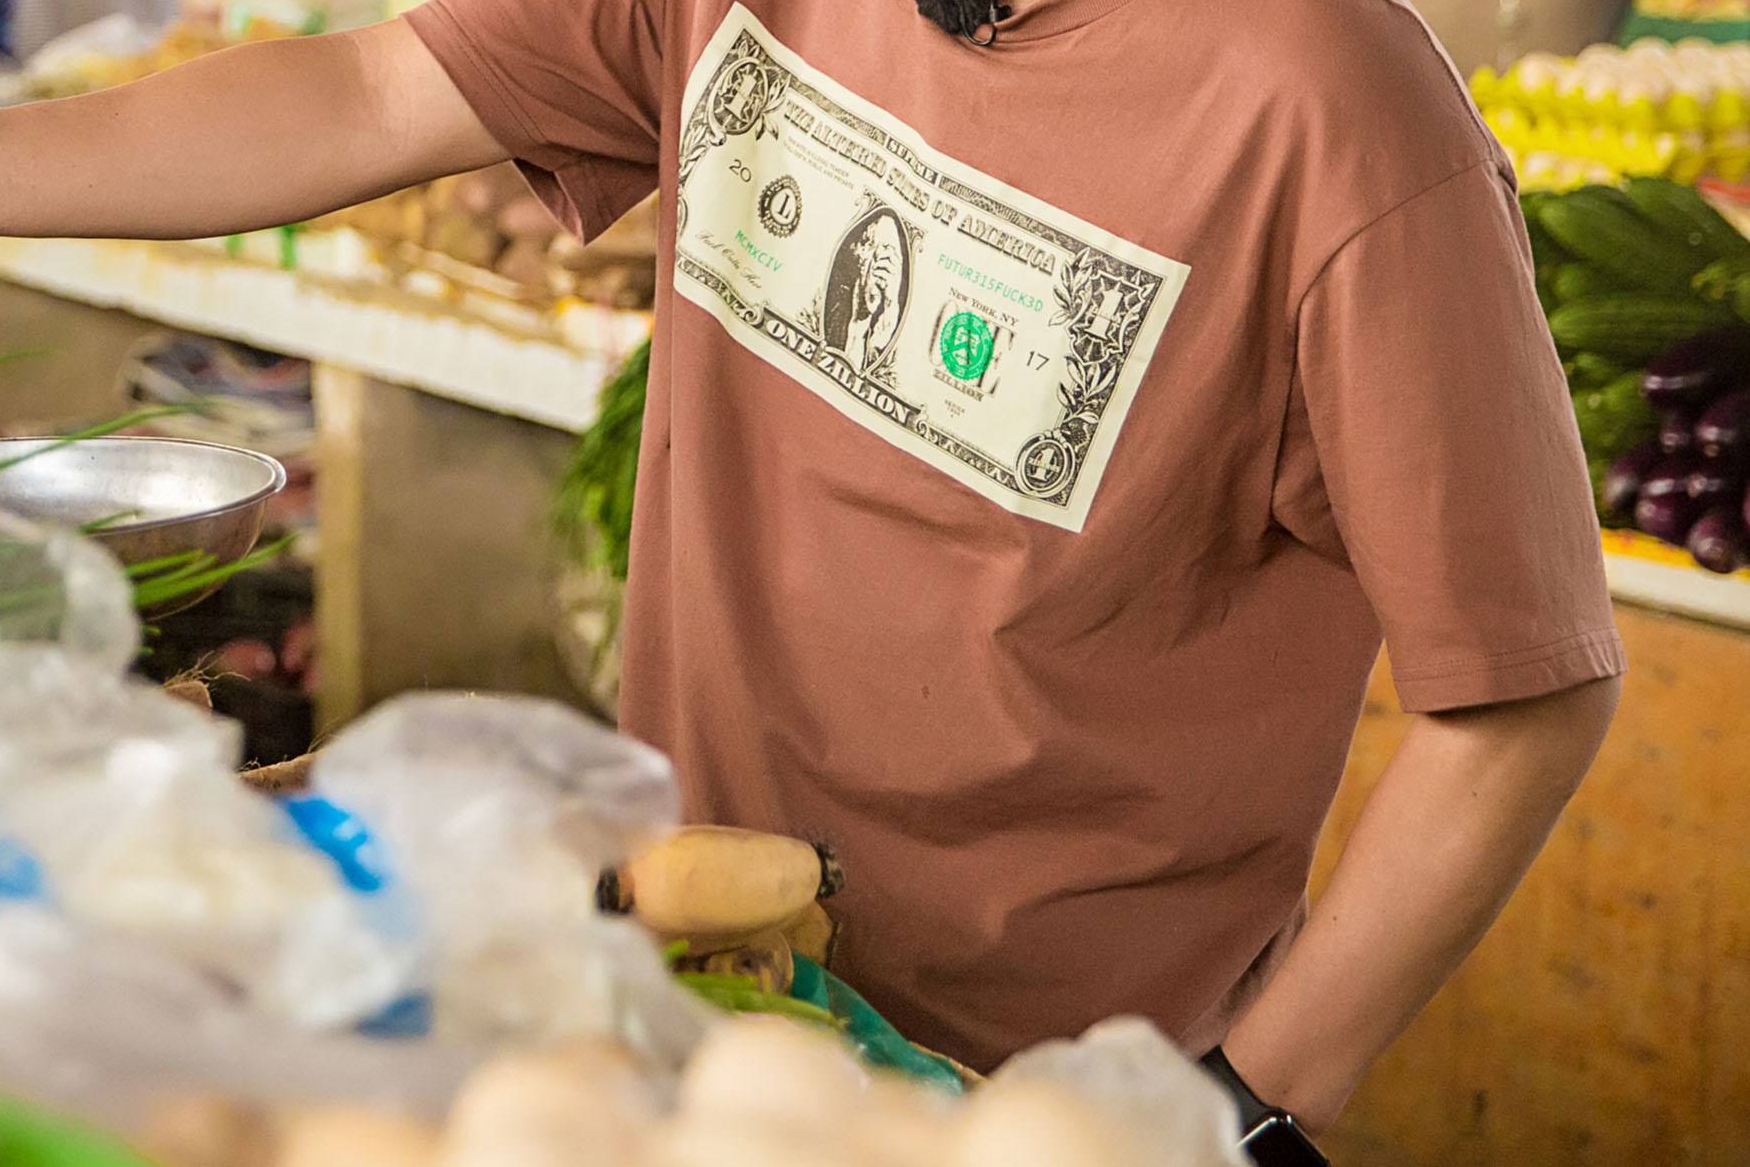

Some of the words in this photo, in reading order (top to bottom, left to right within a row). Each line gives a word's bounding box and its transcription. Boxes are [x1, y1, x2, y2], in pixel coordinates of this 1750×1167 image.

[729, 159, 752, 183] 20
[811, 121, 888, 179] ALTERED
[931, 200, 957, 226] OF
[956, 214, 1056, 276] AMERICA
[735, 229, 784, 272] MCMXCIV
[1000, 312, 1019, 328] NY
[766, 319, 817, 361] ONE
[817, 351, 912, 425] ZILLION
[1026, 350, 1050, 371] 17
[932, 368, 985, 403] ZILLION
